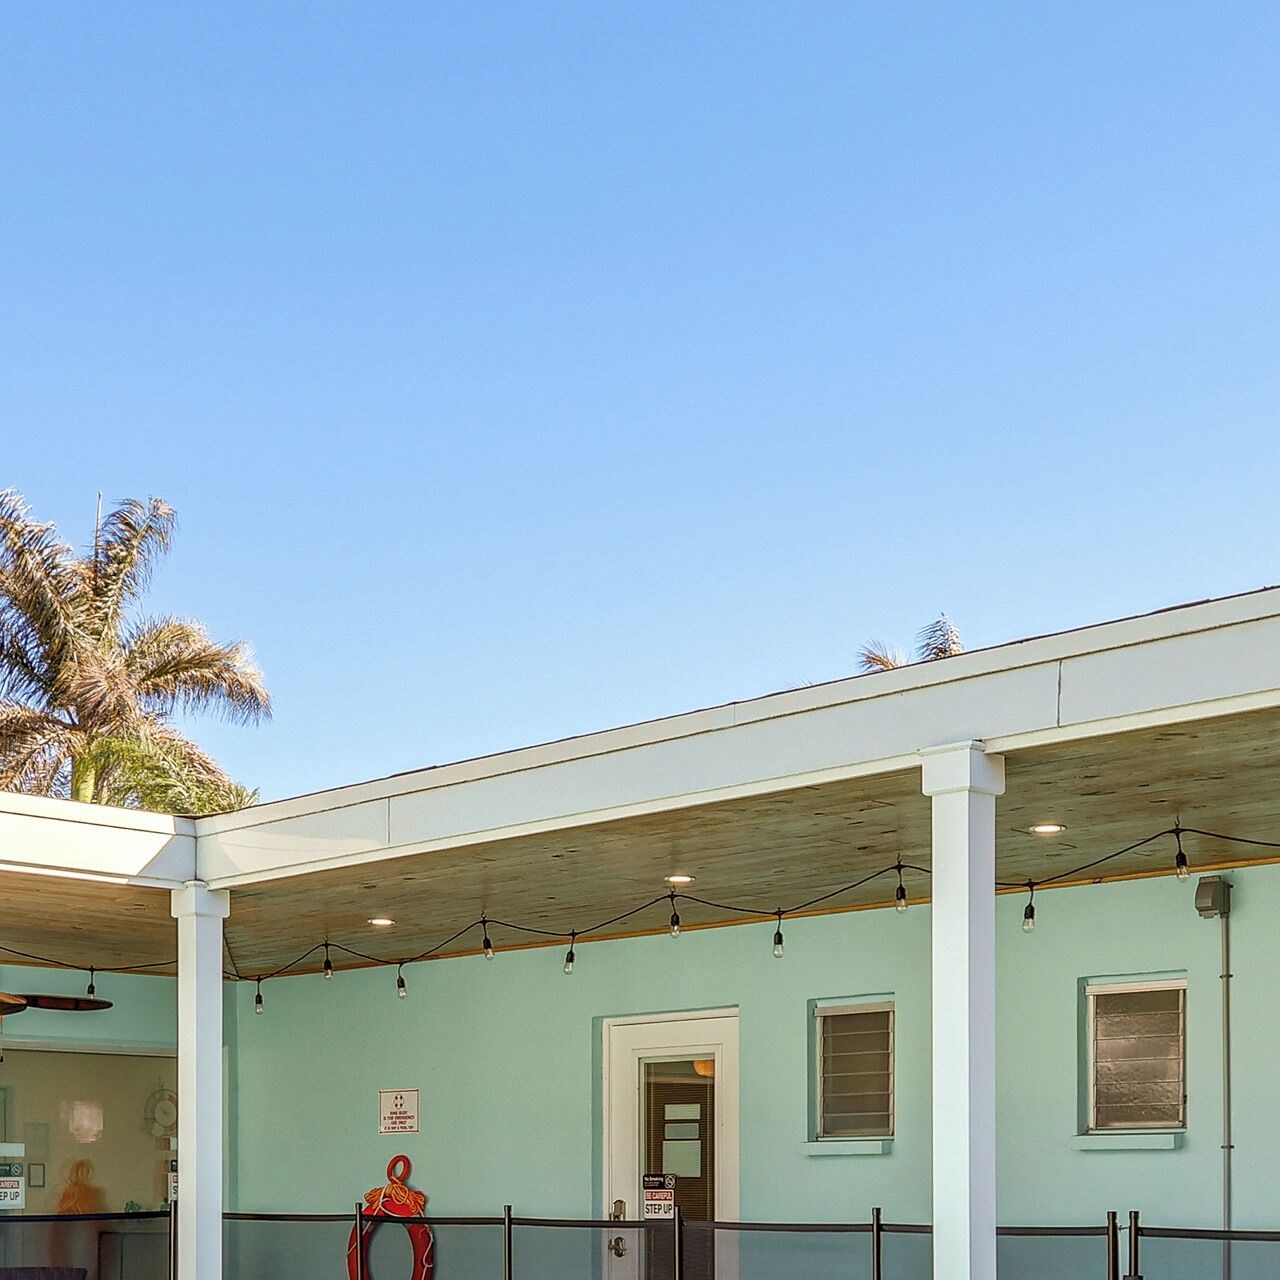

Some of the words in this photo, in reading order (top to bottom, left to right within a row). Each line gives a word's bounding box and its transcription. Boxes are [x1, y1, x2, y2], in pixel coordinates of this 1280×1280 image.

[10, 1191, 20, 1200] UP
[645, 1204, 662, 1214] STEP
[663, 1204, 673, 1214] UP
